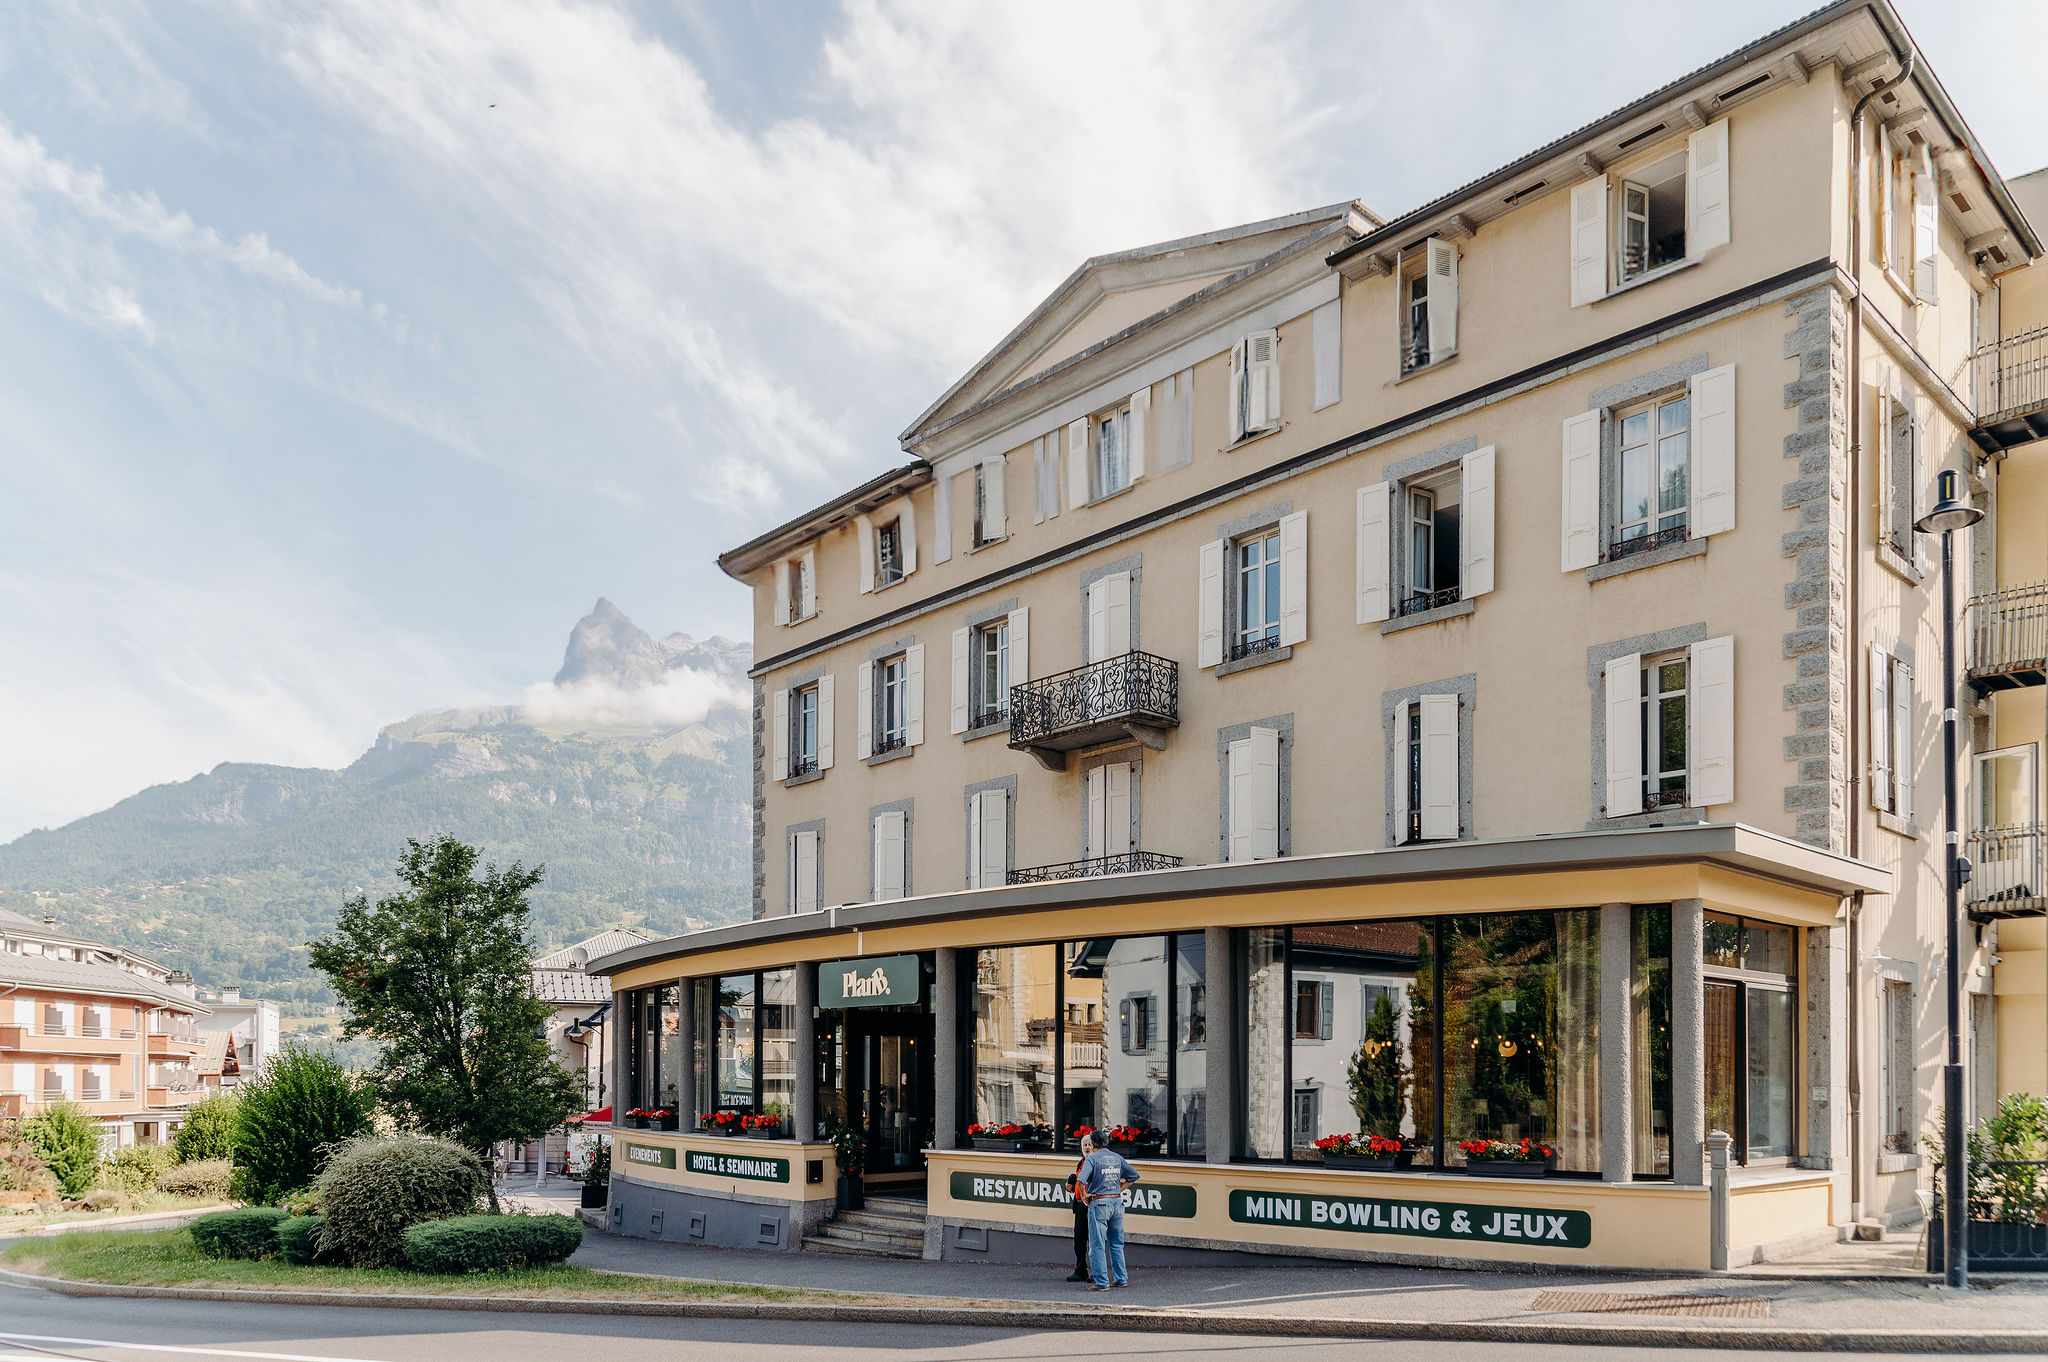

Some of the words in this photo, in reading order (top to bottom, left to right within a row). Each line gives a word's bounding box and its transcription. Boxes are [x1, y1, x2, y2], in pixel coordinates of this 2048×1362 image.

[630, 1147, 662, 1163] EVENEMENTS
[693, 1155, 717, 1172] HOTEL
[718, 1157, 725, 1173] &
[727, 1158, 778, 1178] SEMINAIRE
[973, 1178, 1075, 1203] RESTAURAN
[1121, 1188, 1162, 1210] BAR
[1246, 1196, 1300, 1221] MINI
[1311, 1201, 1441, 1231] BOWLING
[1450, 1210, 1472, 1234] &
[1482, 1212, 1568, 1240] JEUX
